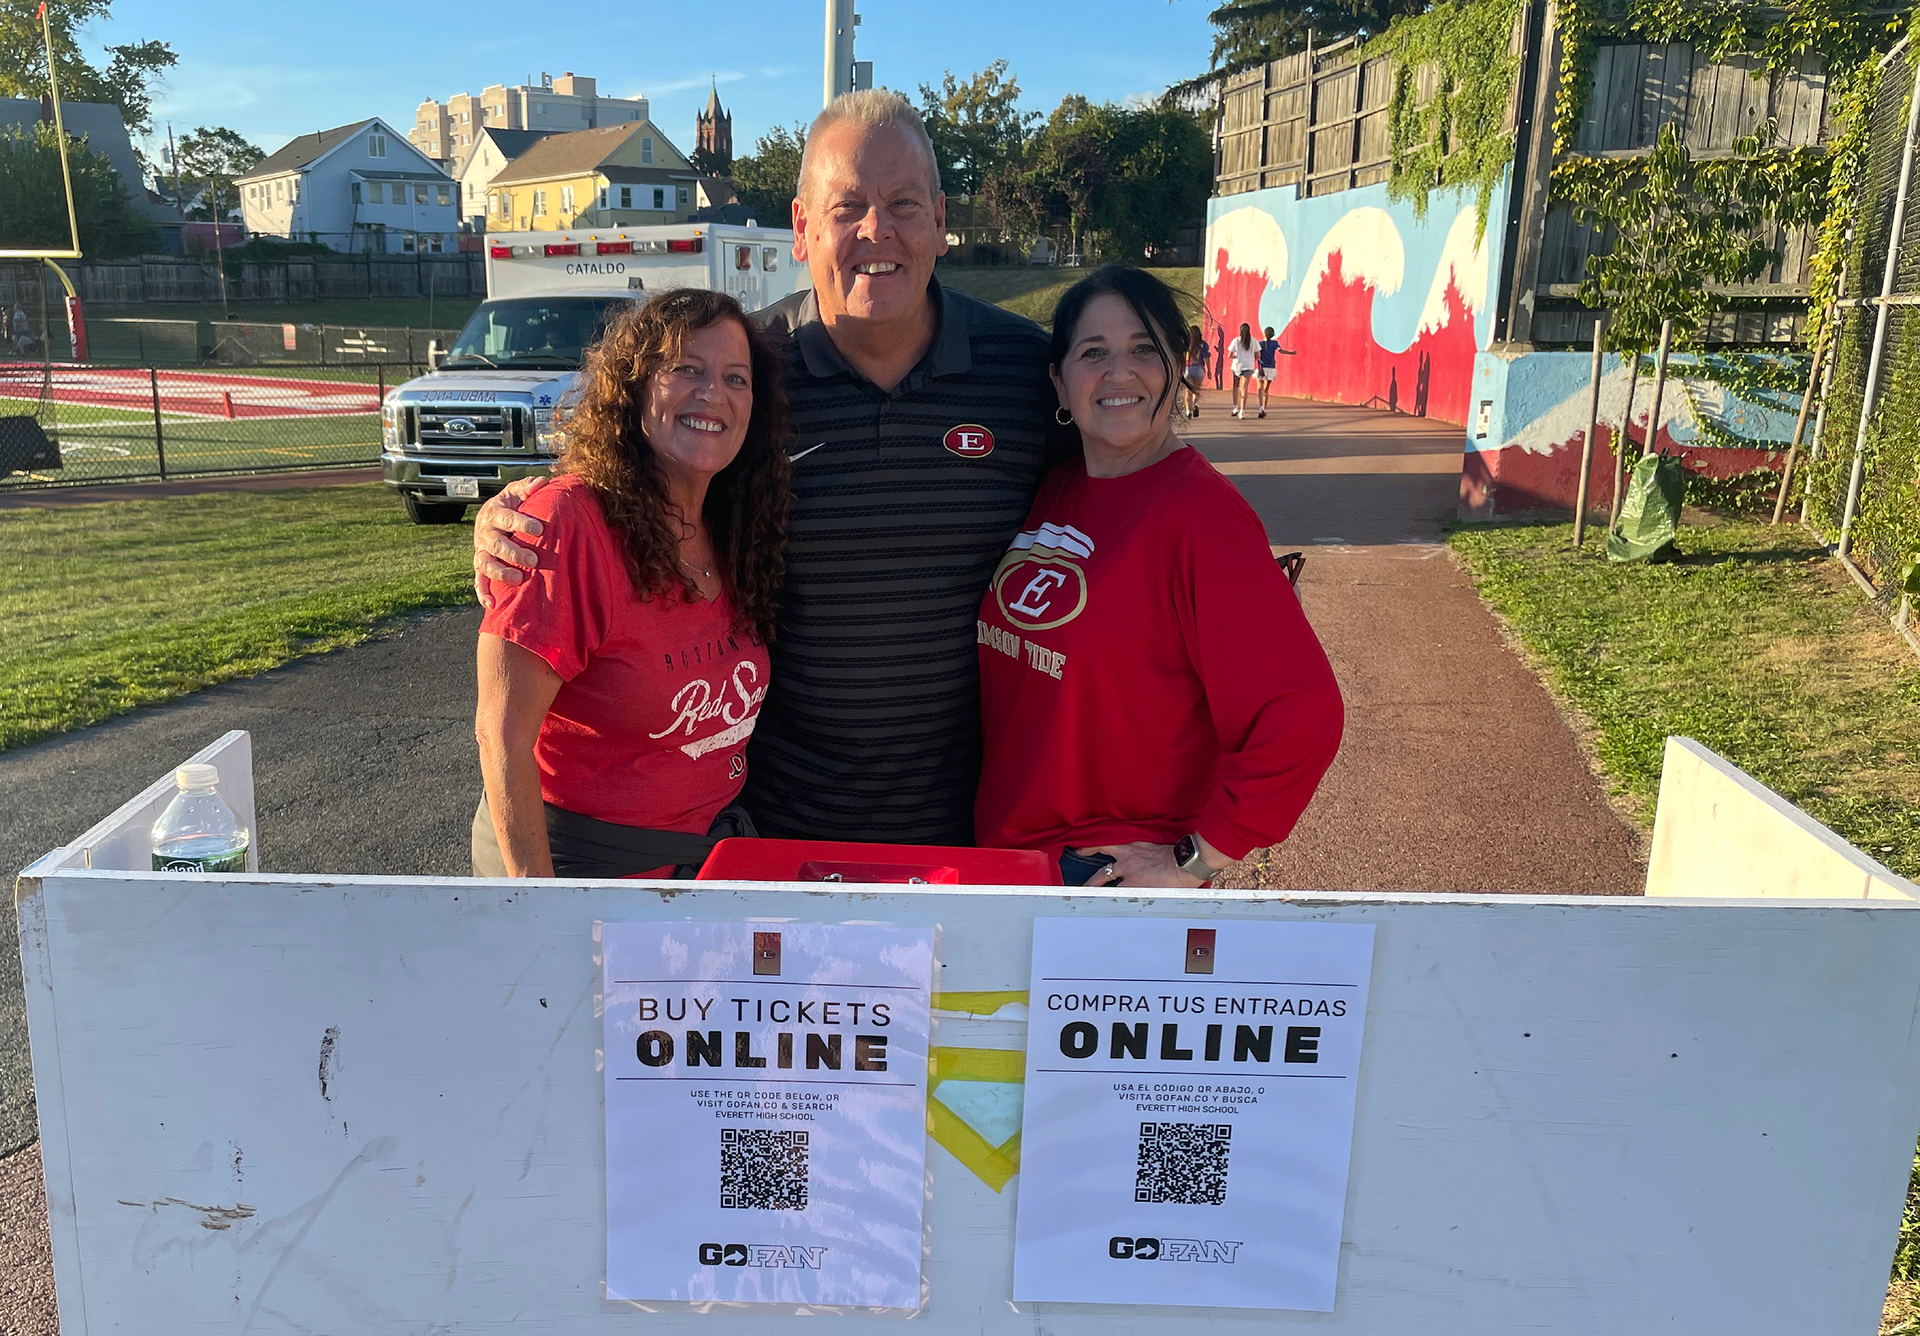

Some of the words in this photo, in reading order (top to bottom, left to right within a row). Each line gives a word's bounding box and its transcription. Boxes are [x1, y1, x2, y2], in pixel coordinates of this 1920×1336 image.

[566, 262, 626, 275] CATALDO
[957, 432, 985, 450] E
[1008, 567, 1068, 618] E
[1024, 639, 1067, 681] TIDE
[648, 678, 728, 740] Red
[638, 997, 717, 1022] BUY
[730, 998, 891, 1027] TICKETS
[1046, 993, 1151, 1013] COMPRA
[1157, 995, 1206, 1015] TUS
[1214, 996, 1347, 1018] ENTRADAS
[636, 1029, 889, 1072] ONLINE
[1059, 1020, 1322, 1065] ONLINE
[690, 1090, 711, 1098] USE
[713, 1090, 734, 1099] THE
[736, 1091, 751, 1099] QR
[753, 1091, 782, 1100] CODE
[825, 1093, 841, 1102] OR
[1113, 1083, 1135, 1092] USA
[1137, 1083, 1151, 1092] EL
[1153, 1082, 1194, 1093] CÓDIGO
[1197, 1085, 1212, 1094] QR
[1257, 1086, 1266, 1095] O
[697, 1100, 724, 1108] VISIT
[726, 1100, 778, 1110] GOFAN.CO
[781, 1102, 789, 1110] &
[791, 1102, 834, 1111] SEARCH
[1118, 1092, 1153, 1101] VISITA
[1155, 1093, 1209, 1103] GOFAN.CO
[1212, 1095, 1220, 1103] Y
[1222, 1095, 1259, 1104] BUSCA
[715, 1110, 755, 1119] EVERETT
[756, 1111, 778, 1120] HIGH
[779, 1112, 816, 1121] SCHOOL
[1136, 1103, 1177, 1113] EVERETT
[1178, 1104, 1201, 1113] HIGH
[1202, 1105, 1240, 1114] SCHOOL
